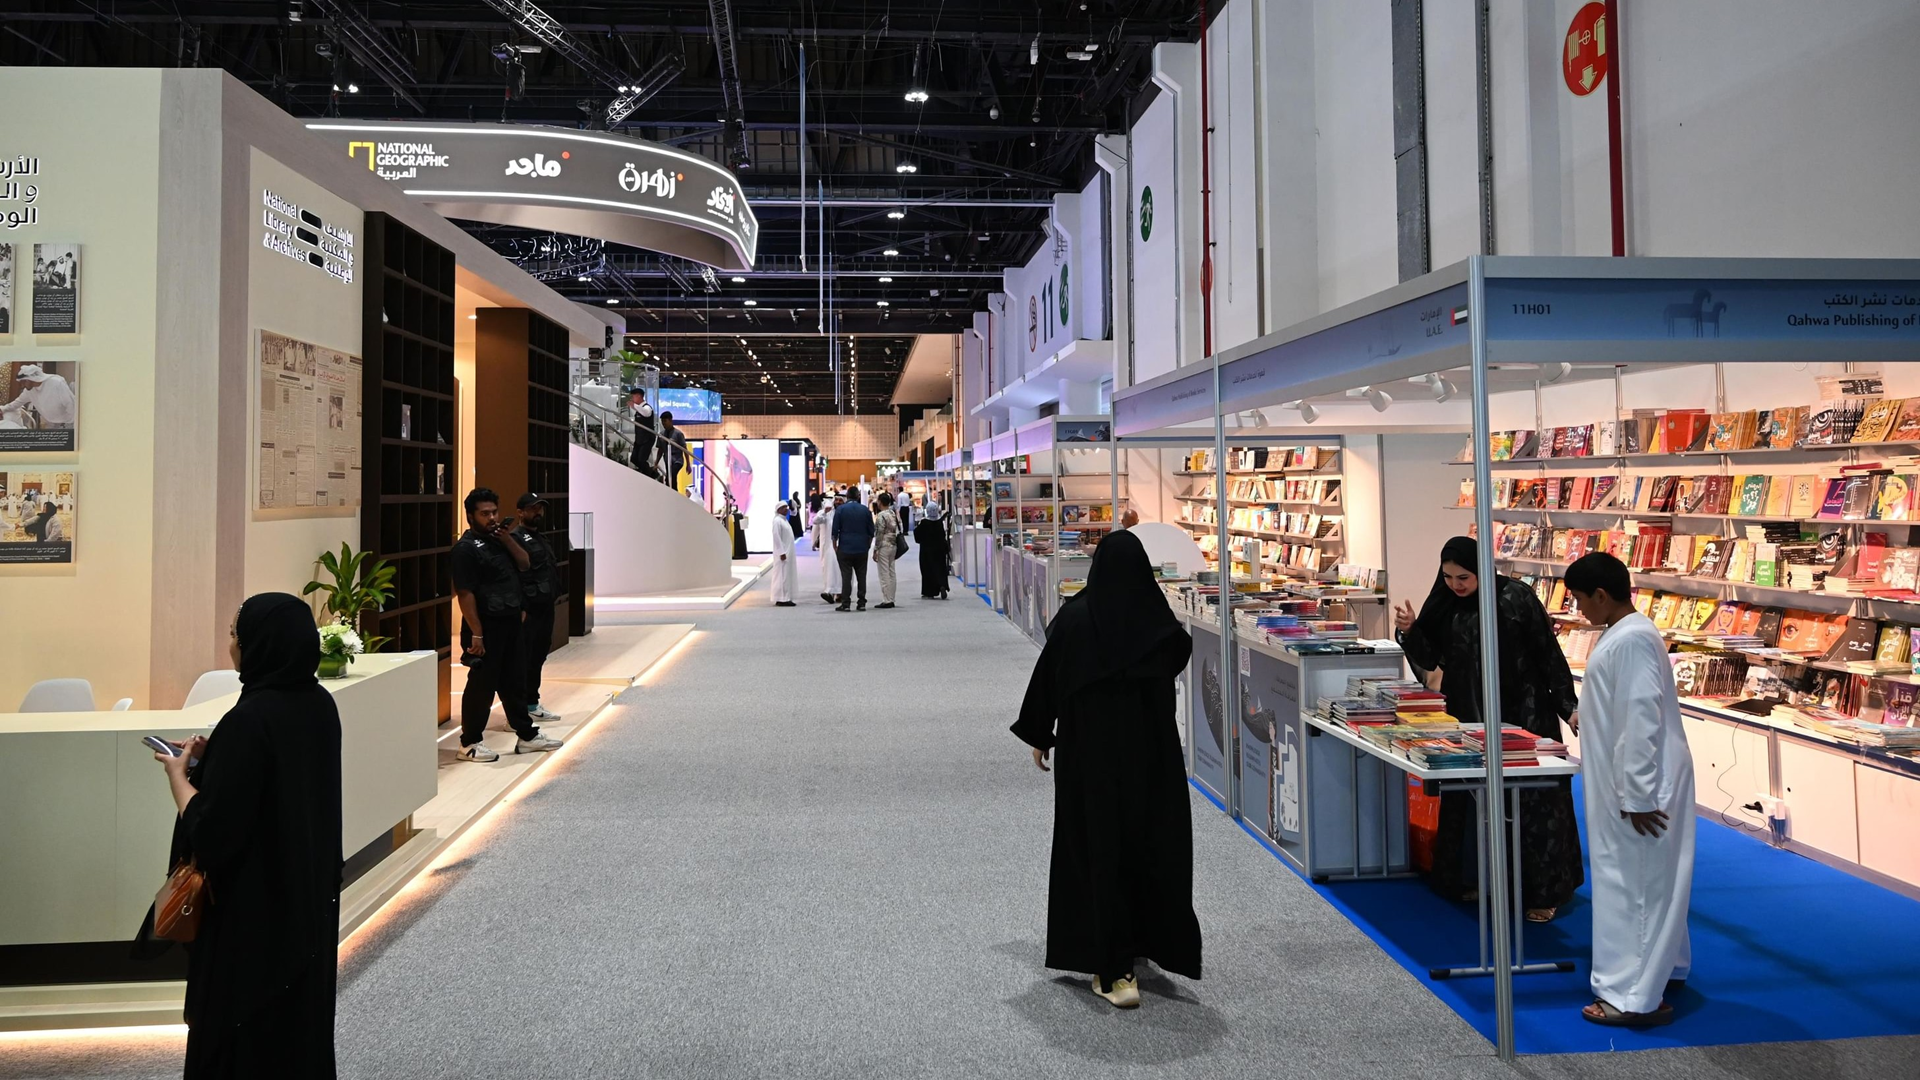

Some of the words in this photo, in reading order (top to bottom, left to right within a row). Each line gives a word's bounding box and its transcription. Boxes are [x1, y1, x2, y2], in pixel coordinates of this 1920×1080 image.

[377, 142, 435, 155] NATIONAL
[376, 154, 450, 167] GEOGRAPHIC
[505, 153, 562, 178] ماجد
[376, 167, 416, 180] العربية
[263, 189, 298, 219] National
[263, 209, 293, 239] Library
[323, 223, 354, 247] الأرشيف
[324, 256, 353, 284] الوطنية
[1824, 294, 1858, 309] الكتب
[1860, 292, 1887, 308] نشر
[1042, 275, 1054, 344] 11
[1512, 303, 1551, 315] 11H01
[1787, 313, 1830, 326] Qahwa
[1834, 314, 1899, 330] Publishing
[1902, 314, 1916, 326] of
